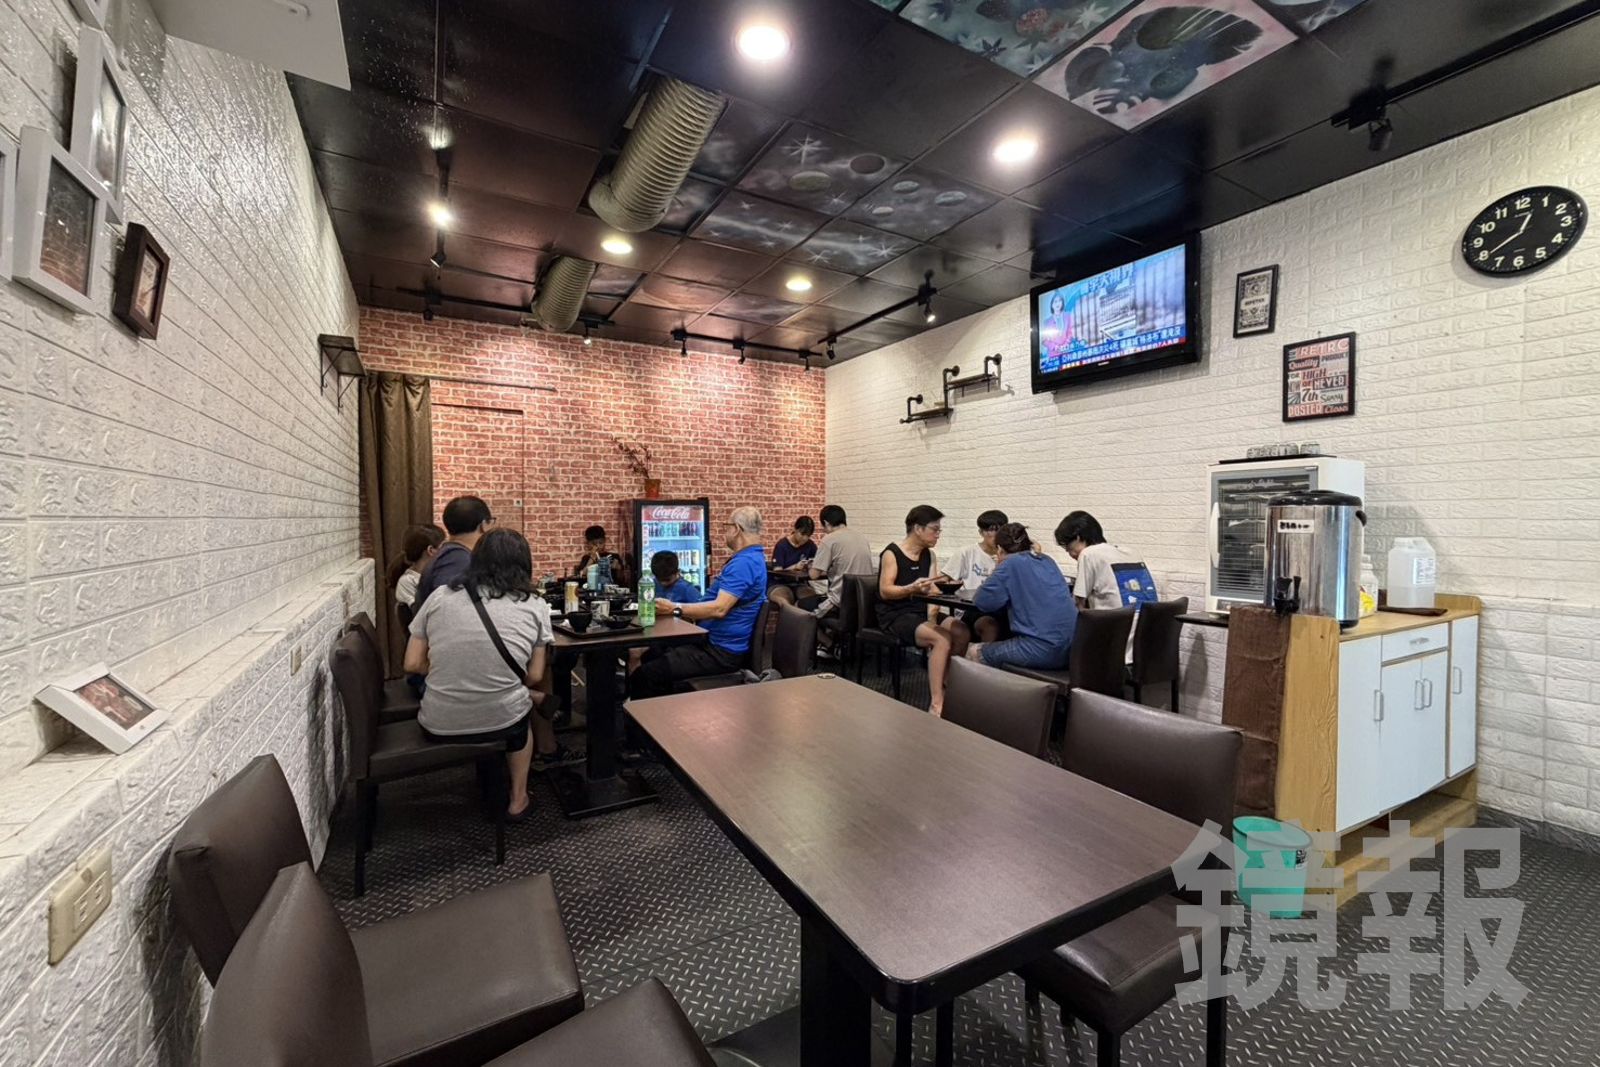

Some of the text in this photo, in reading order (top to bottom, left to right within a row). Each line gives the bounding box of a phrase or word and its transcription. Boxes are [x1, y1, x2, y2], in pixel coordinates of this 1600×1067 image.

[1514, 197, 1531, 210] 12
[1541, 196, 1549, 208] 1
[1495, 207, 1508, 219] 11
[1555, 203, 1567, 215] 2
[1480, 221, 1496, 233] 10
[1560, 215, 1572, 227] 3
[1473, 237, 1484, 248] 9
[1551, 232, 1563, 244] 4
[1479, 250, 1489, 261] 8
[1535, 247, 1547, 258] 5
[1494, 256, 1505, 267] 7
[1513, 256, 1524, 267] 6
[1314, 376, 1345, 389] NEVER
[1302, 388, 1318, 402] 7th
